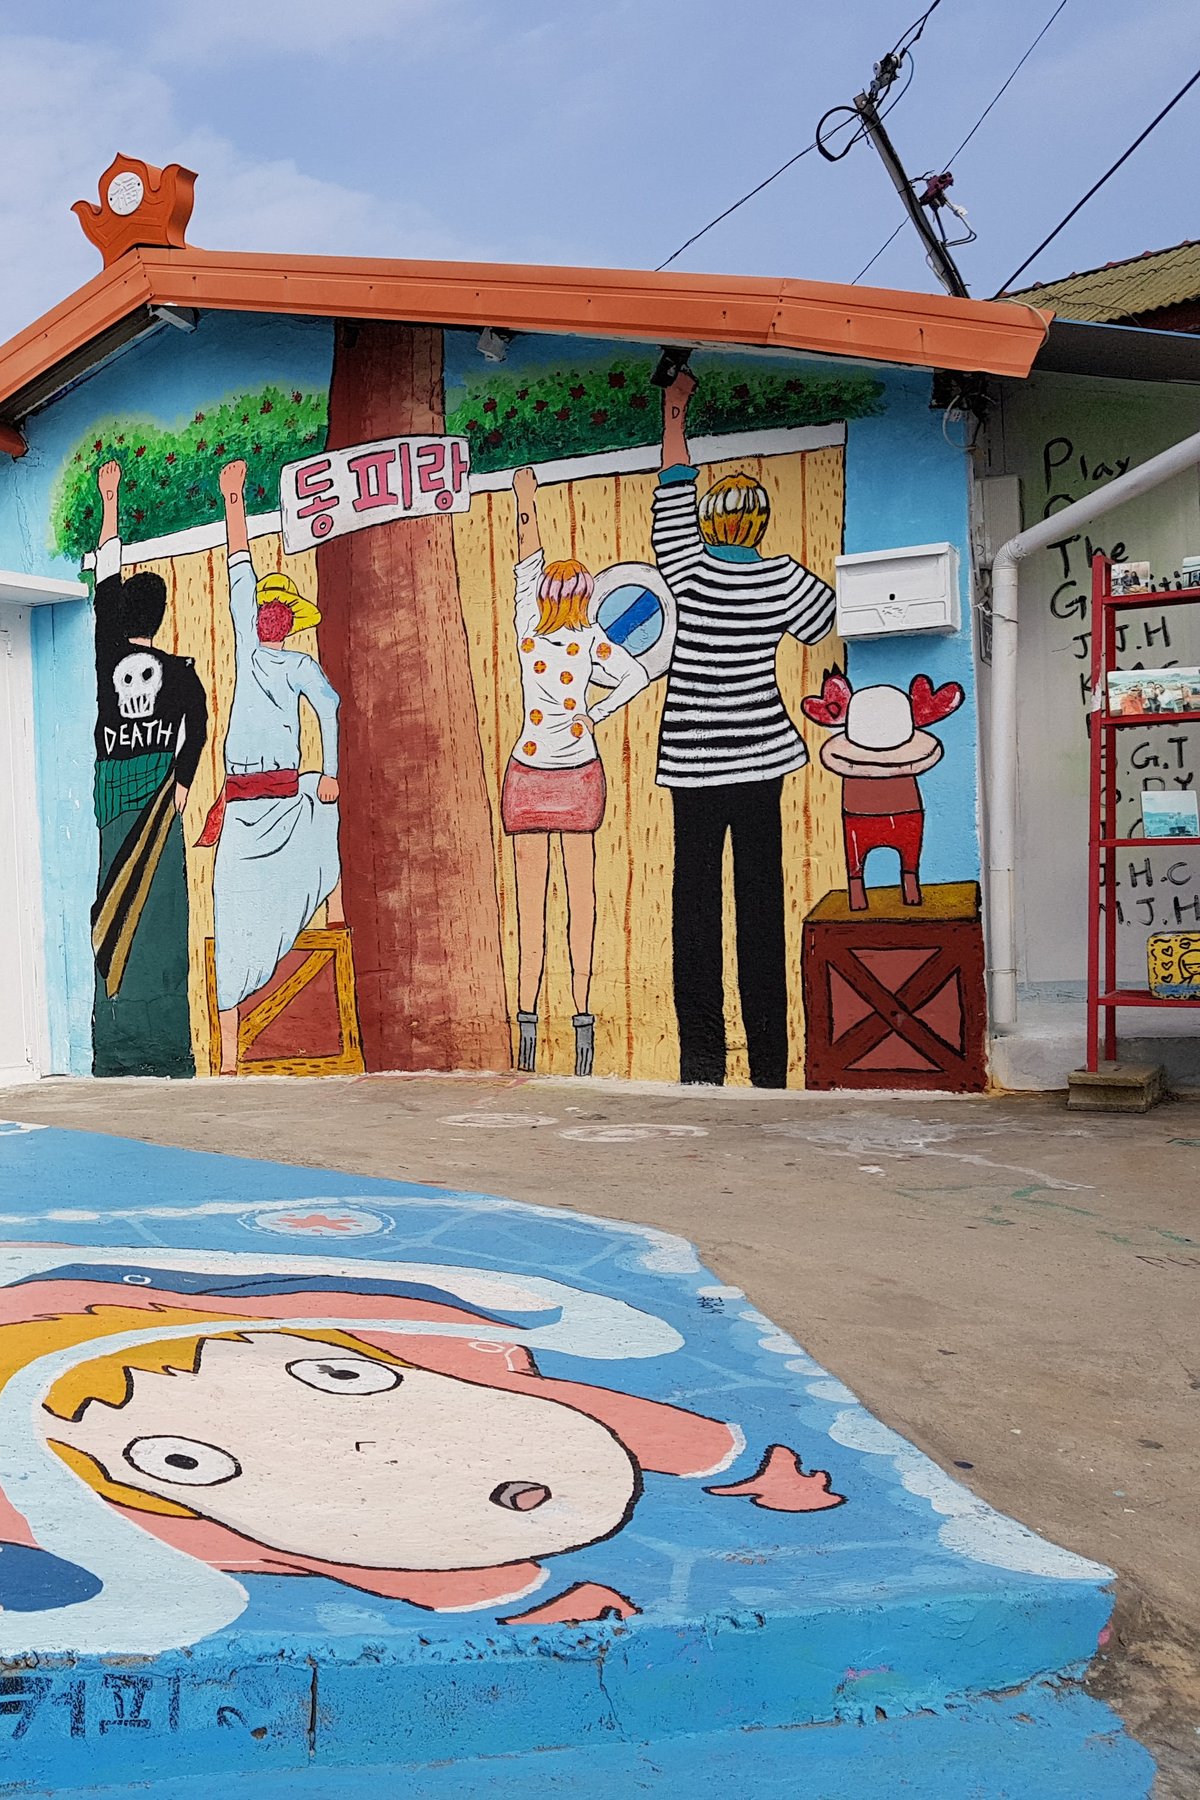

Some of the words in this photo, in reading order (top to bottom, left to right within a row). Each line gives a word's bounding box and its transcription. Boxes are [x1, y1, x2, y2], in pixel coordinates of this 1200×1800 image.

[296, 442, 469, 538] 동피랑
[1044, 437, 1130, 494] Play
[1047, 534, 1129, 579] The
[104, 719, 173, 755] DEATH
